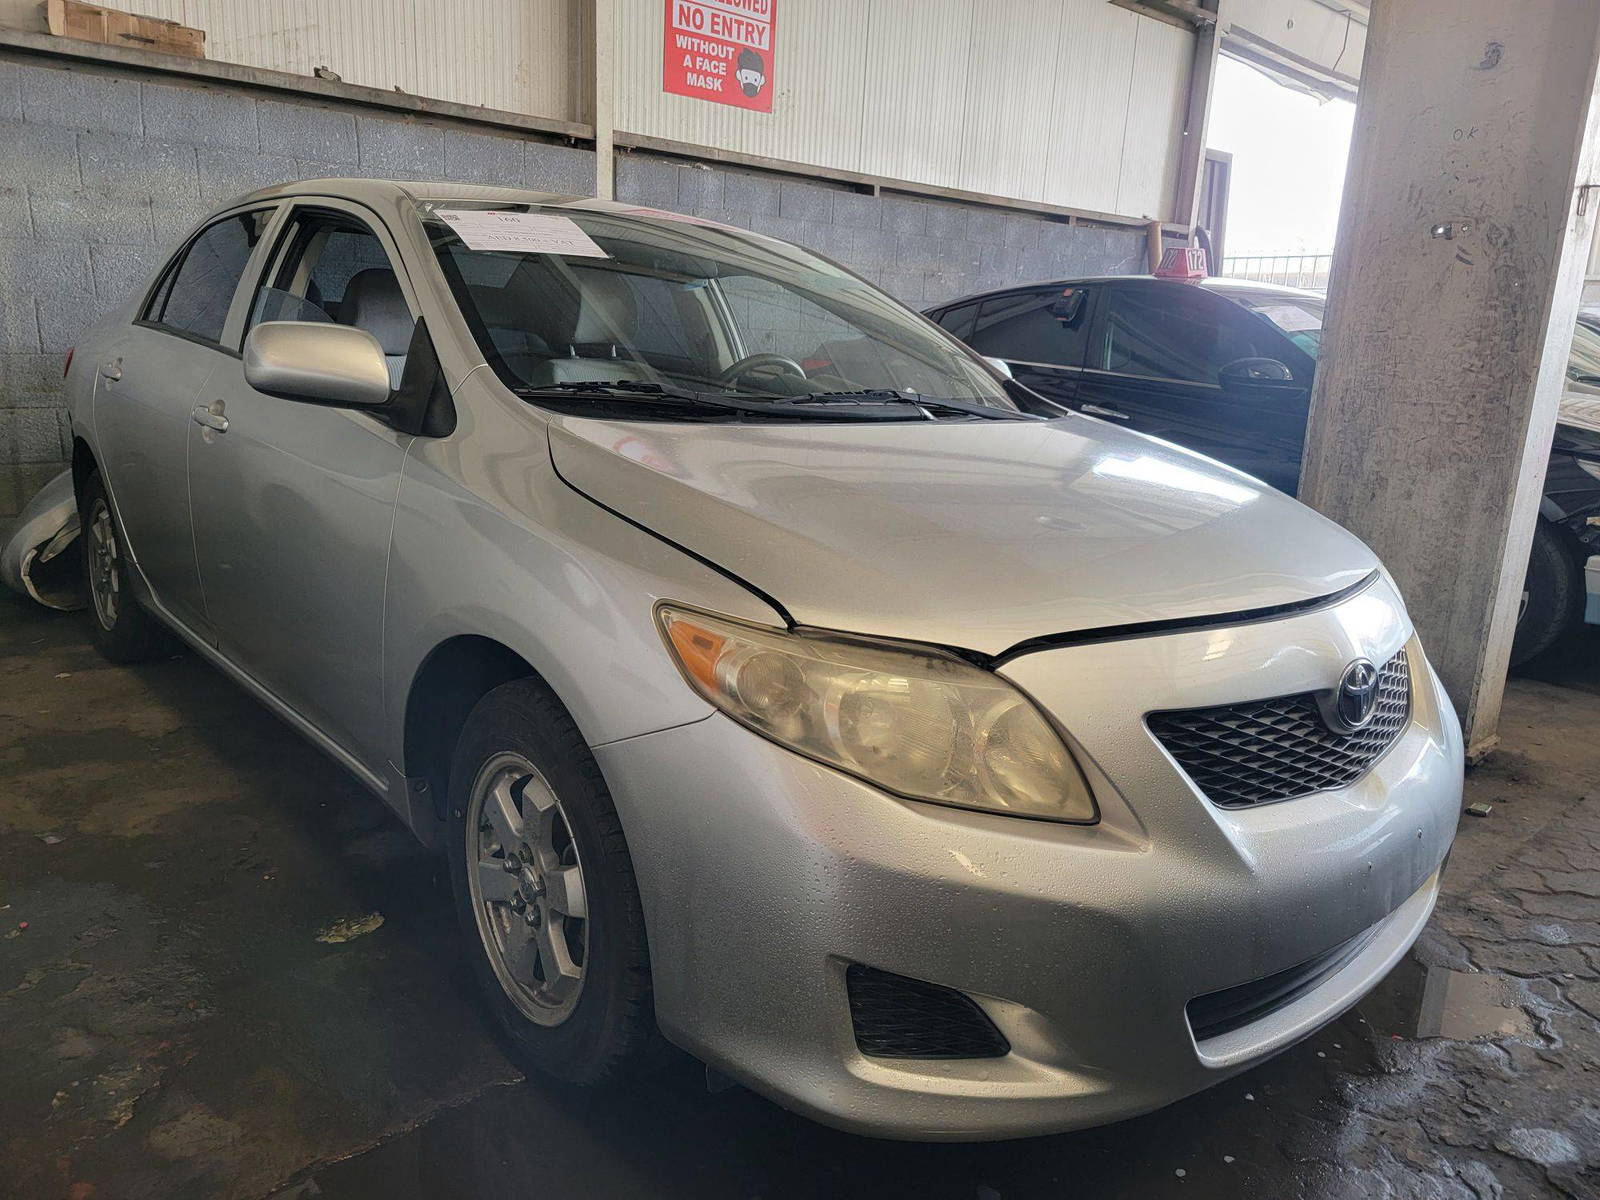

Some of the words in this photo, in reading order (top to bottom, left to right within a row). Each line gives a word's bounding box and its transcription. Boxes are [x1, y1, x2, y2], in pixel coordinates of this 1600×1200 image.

[679, 4, 704, 30] NO
[711, 12, 766, 46] ENTRY
[675, 34, 735, 60] WITHOUT
[683, 54, 692, 68] A
[696, 56, 727, 76] FACE
[686, 72, 723, 92] MASK
[1188, 249, 1204, 271] 172
